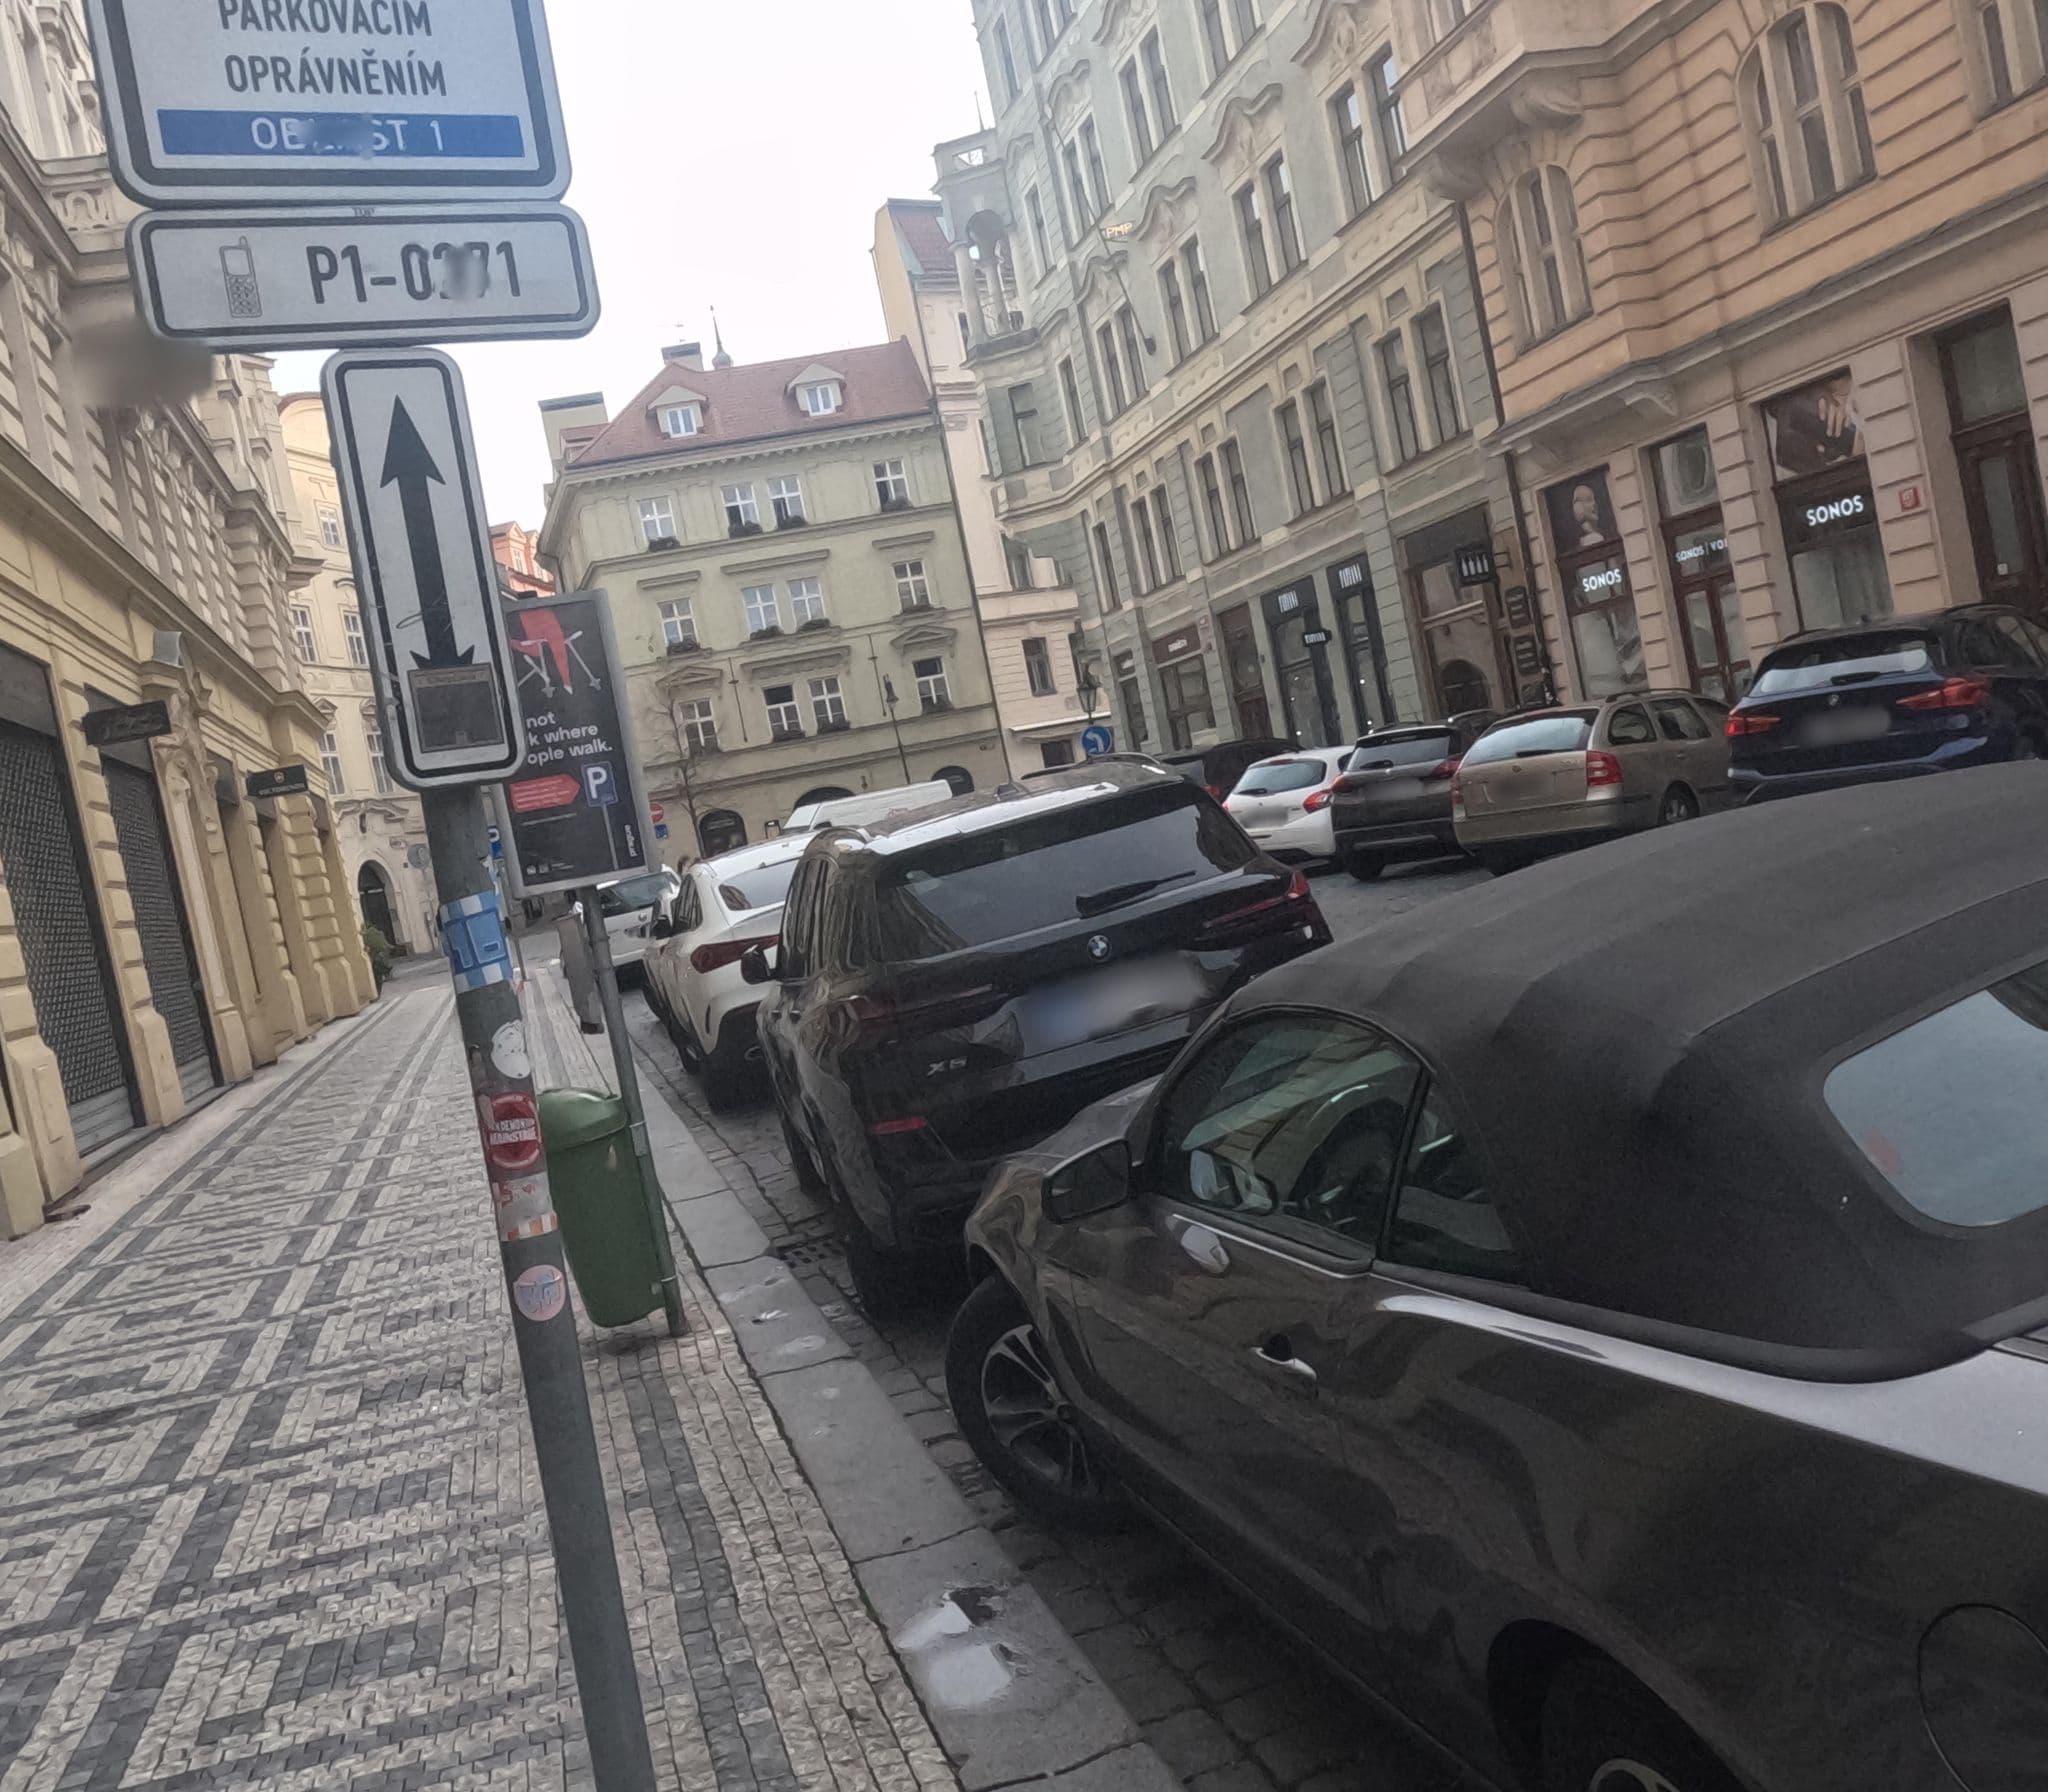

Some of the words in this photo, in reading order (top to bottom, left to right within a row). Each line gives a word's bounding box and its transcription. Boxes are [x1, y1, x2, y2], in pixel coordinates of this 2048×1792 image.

[224, 46, 447, 96] OPRÁVNĚNÍM
[251, 117, 408, 151] OBST
[430, 120, 443, 151] 1
[1806, 495, 1864, 526] SONOS
[1675, 545, 1705, 562] SONOS
[1582, 568, 1622, 592] SONOS
[526, 711, 556, 729] not
[544, 725, 598, 743] where
[527, 747, 564, 766] ople
[569, 739, 613, 756] walk.
